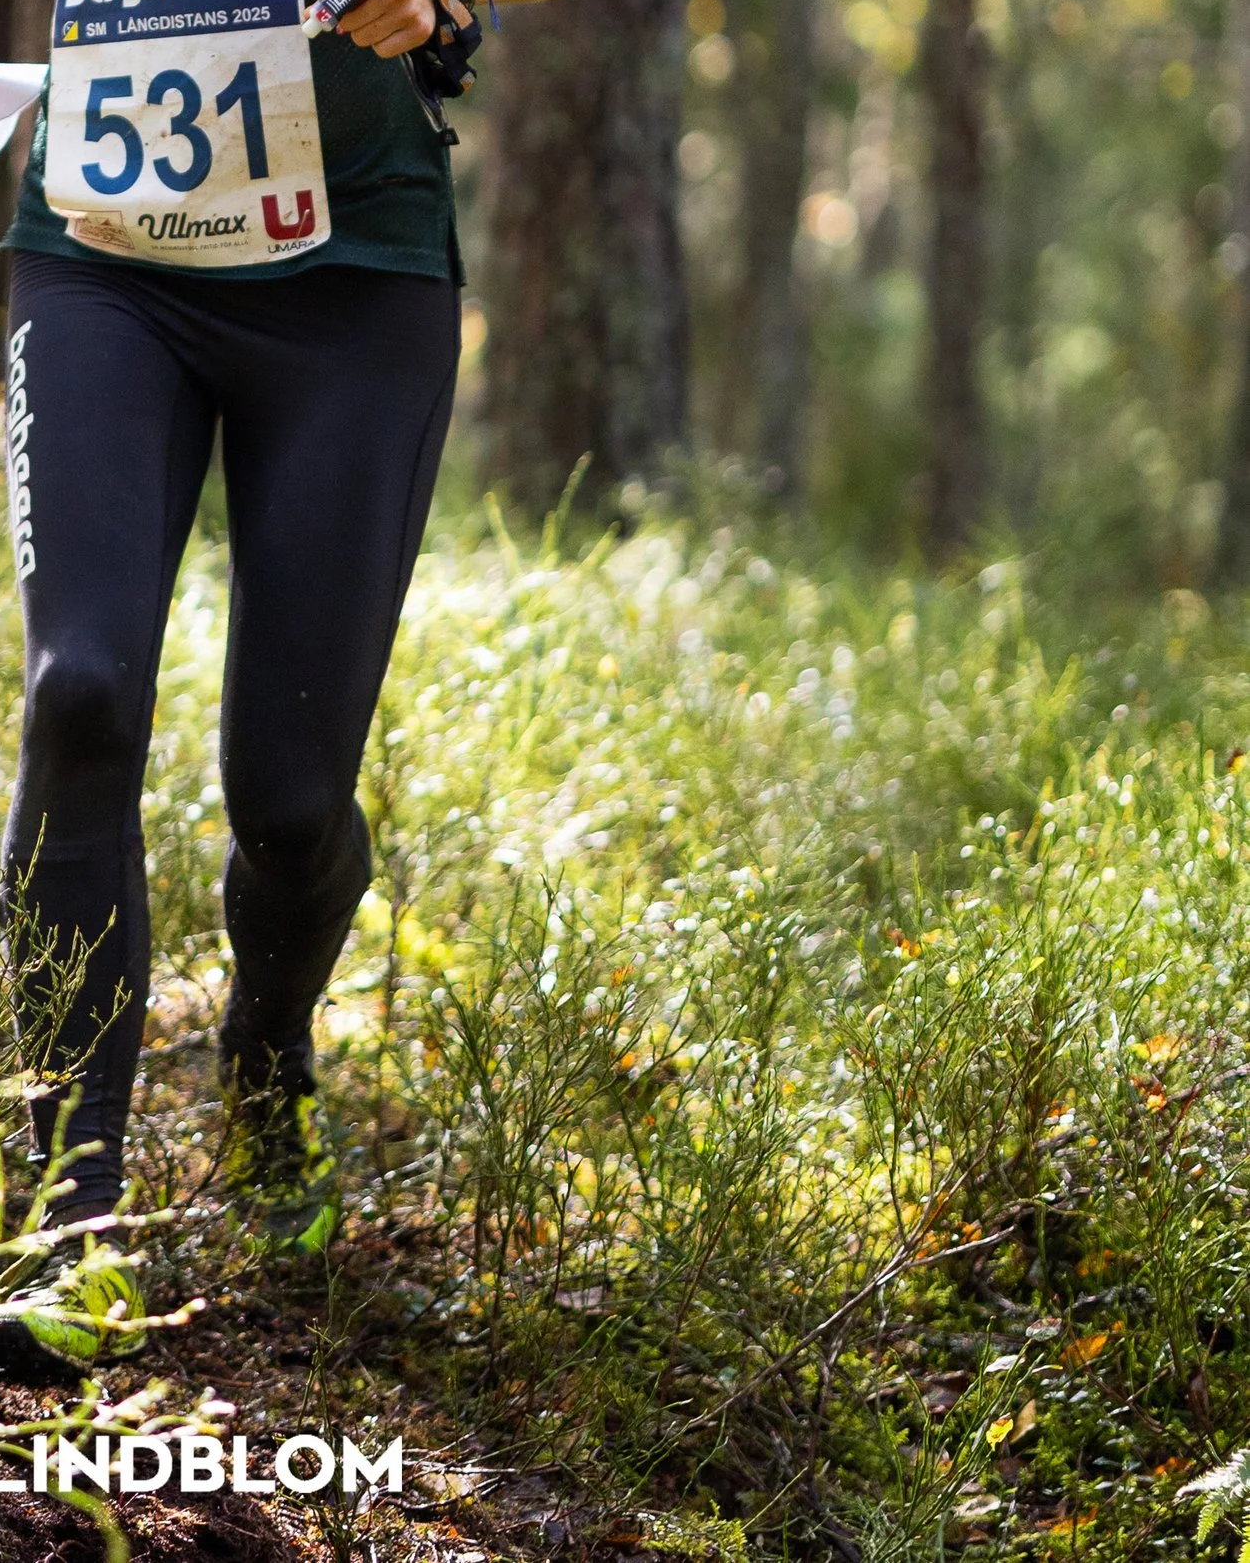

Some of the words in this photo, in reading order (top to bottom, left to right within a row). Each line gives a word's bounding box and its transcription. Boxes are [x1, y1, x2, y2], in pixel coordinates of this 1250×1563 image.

[86, 22, 107, 37] SM
[118, 9, 228, 34] LÅNGDISTANS
[232, 6, 271, 23] 2025
[81, 61, 270, 195] 531
[137, 211, 247, 240] Ullmax
[267, 239, 316, 254] UMARA
